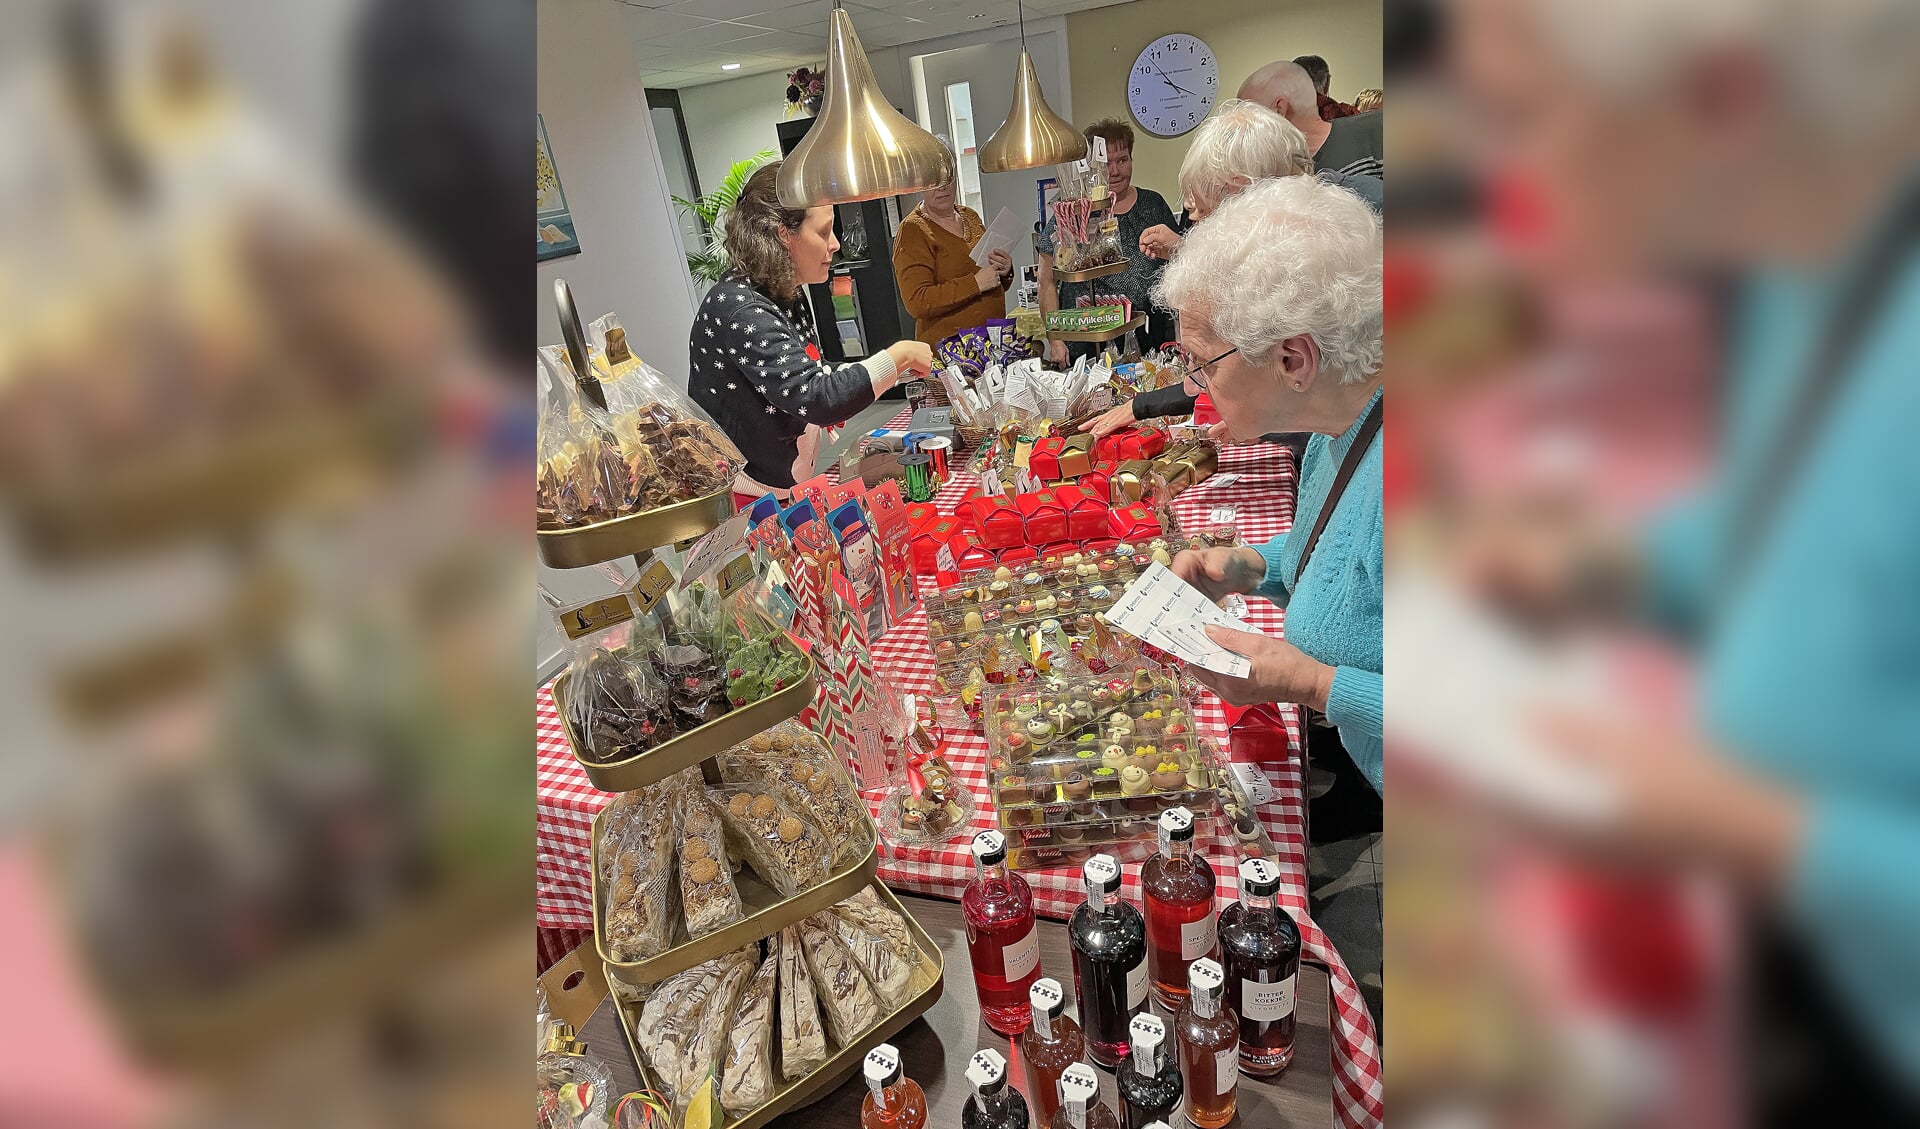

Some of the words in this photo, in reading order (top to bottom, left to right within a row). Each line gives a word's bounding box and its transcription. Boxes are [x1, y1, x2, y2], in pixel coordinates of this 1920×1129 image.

[1166, 42, 1178, 51] 12
[1188, 45, 1194, 54] 1
[1150, 51, 1161, 59] 11
[1200, 57, 1207, 65] 2
[1140, 66, 1151, 74] 10
[1188, 112, 1194, 120] 5
[1154, 117, 1160, 125] 7
[1078, 314, 1103, 325] Mike
[1258, 990, 1284, 998] BITTER
[1255, 995, 1286, 1004] KOEKJES
